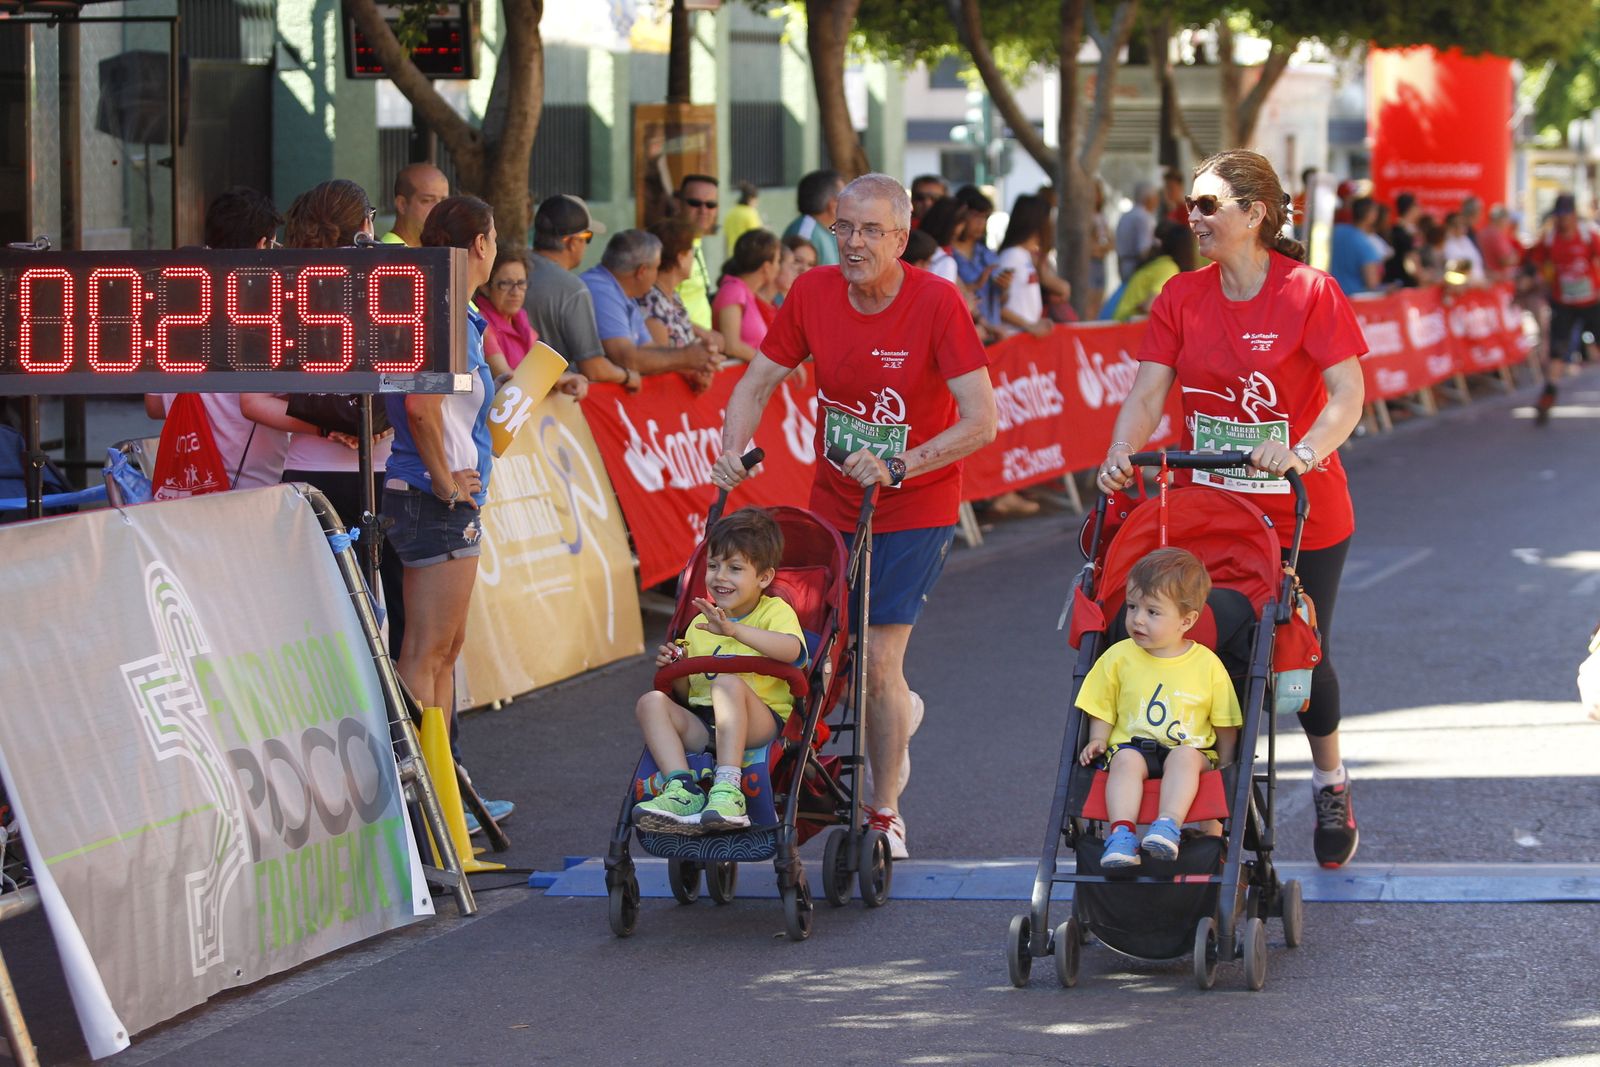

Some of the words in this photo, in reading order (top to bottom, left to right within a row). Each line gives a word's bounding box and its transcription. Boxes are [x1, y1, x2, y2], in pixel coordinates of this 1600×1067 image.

[19, 265, 425, 373] 00:24:59
[1213, 421, 1222, 436] 6
[1146, 683, 1167, 727] 6
[228, 717, 397, 864] POCO
